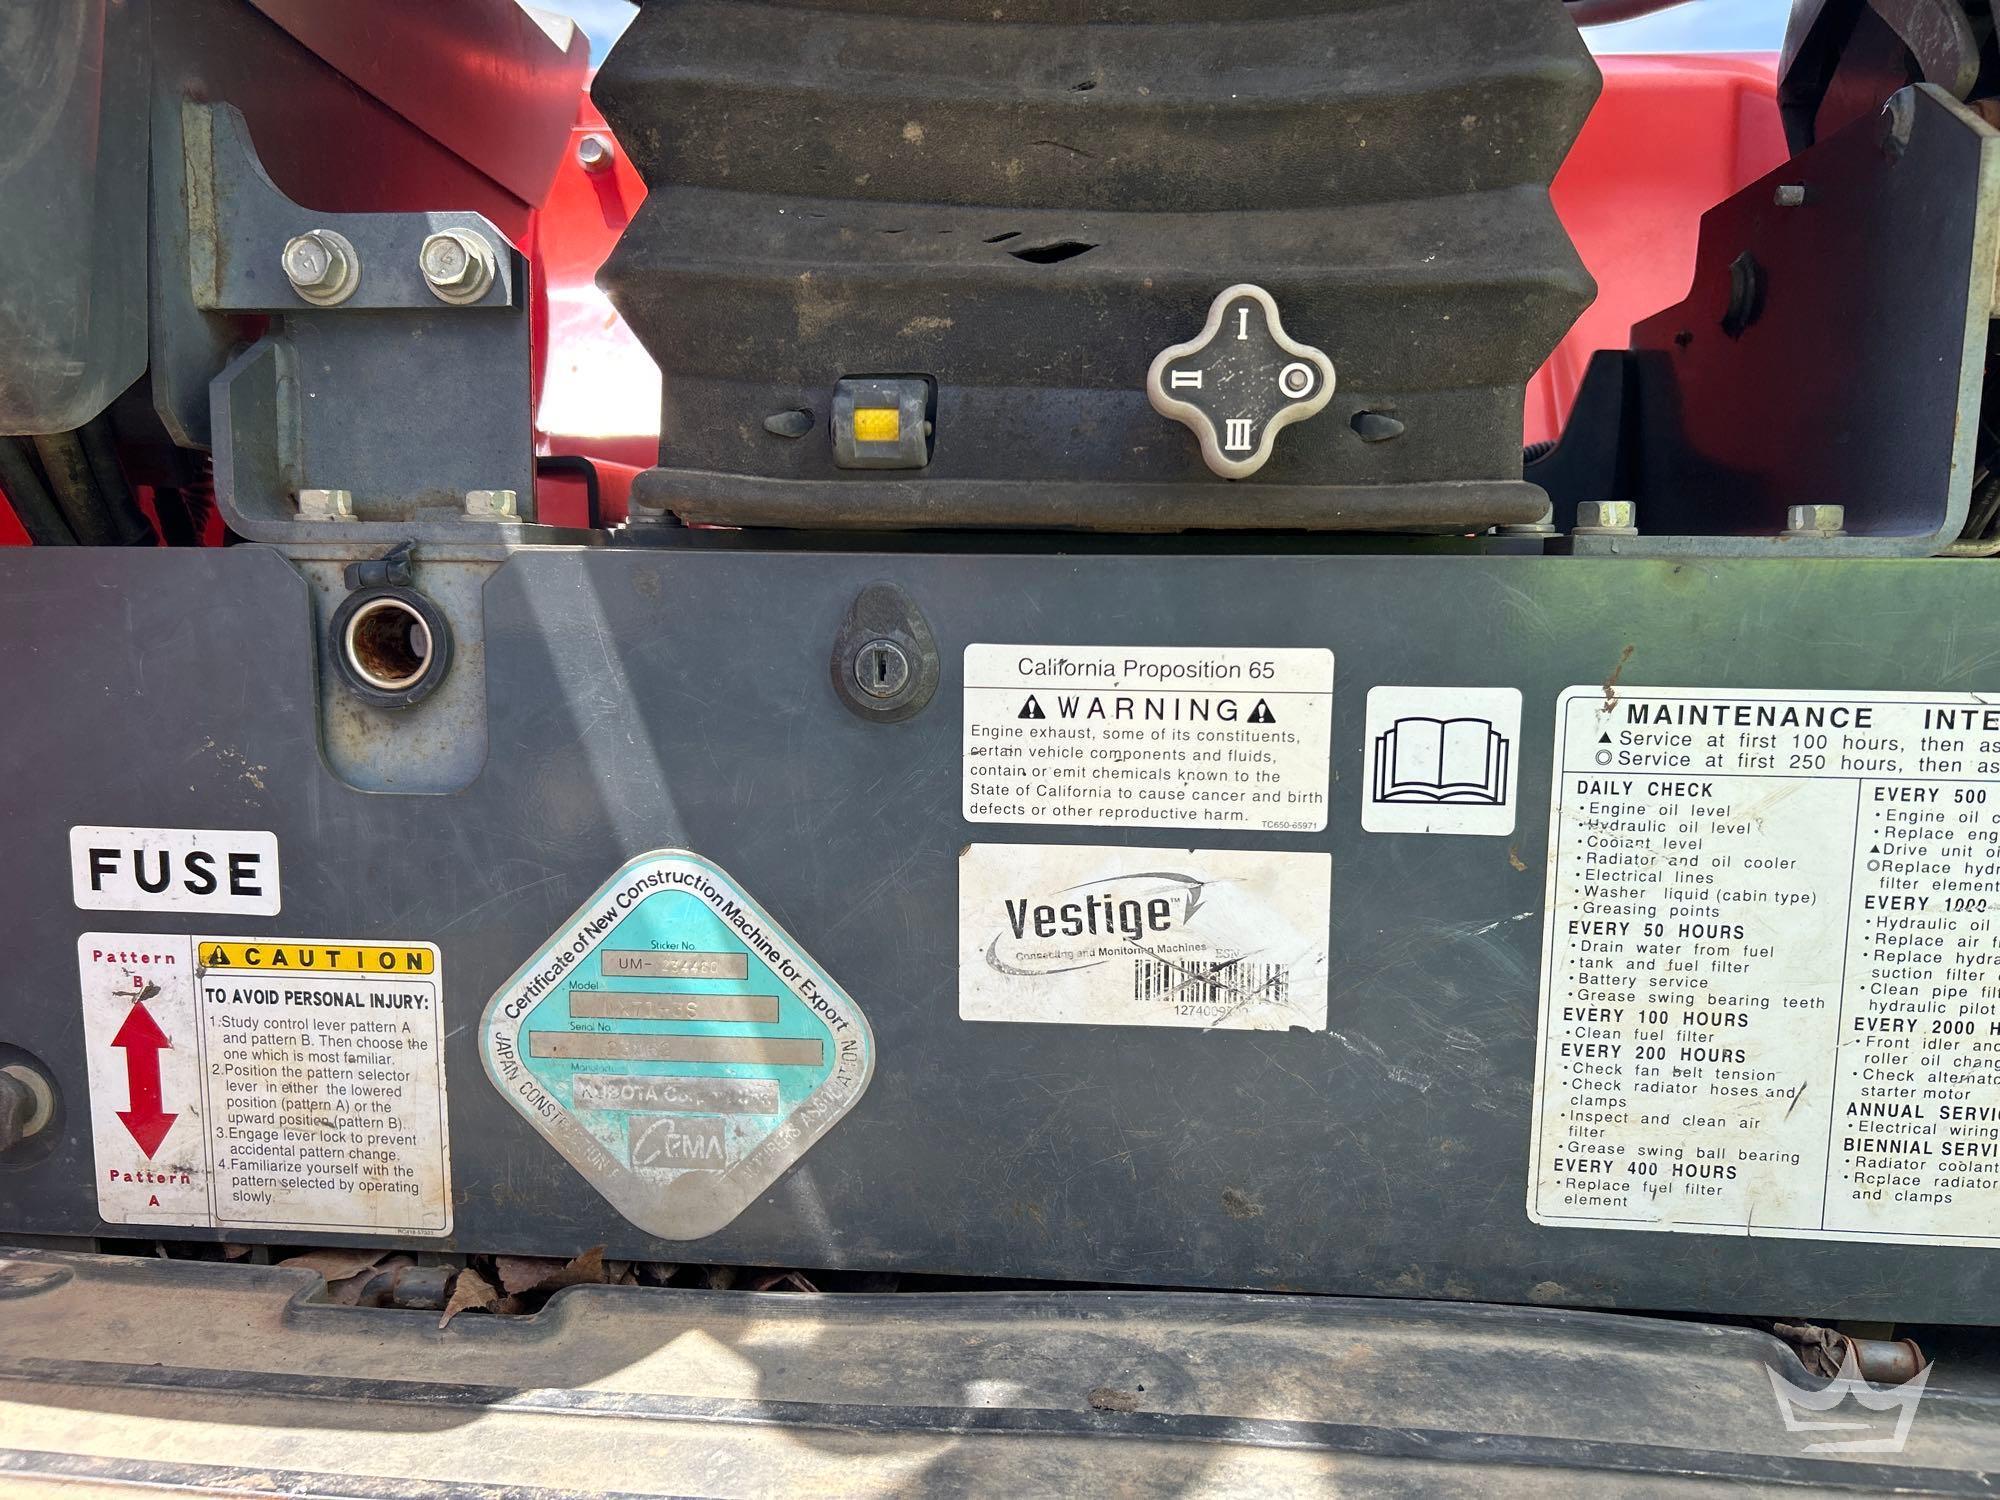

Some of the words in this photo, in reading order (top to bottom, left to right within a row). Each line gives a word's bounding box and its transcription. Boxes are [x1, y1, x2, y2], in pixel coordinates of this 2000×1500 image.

[1018, 657, 1116, 677] California
[1123, 659, 1241, 682] Proposition
[1248, 661, 1275, 679] 65
[1057, 696, 1237, 722] WARNING
[1627, 703, 1872, 728] MAINTENANCE
[971, 724, 1023, 740] Engine
[1029, 725, 1095, 741] exhaust,
[1102, 729, 1144, 740] some
[1150, 727, 1166, 740] of
[1172, 728, 1190, 741] its
[1196, 729, 1300, 744] constituents,
[1619, 730, 1692, 747] Service
[1706, 733, 1725, 747] at
[1738, 732, 1776, 748] first
[1792, 734, 1827, 750] 100
[1842, 734, 1904, 753] hours,
[1920, 735, 1964, 752] then
[970, 744, 1022, 757] certain
[1028, 745, 1083, 759] vehicle
[1090, 749, 1186, 763] components
[1192, 749, 1221, 761] and
[1228, 749, 1276, 764] fluids,
[1617, 750, 1690, 767] Service
[1705, 753, 1723, 767] at
[1737, 752, 1775, 769] first
[1789, 754, 1825, 770] 250
[1840, 754, 1902, 773] hours,
[1918, 756, 1961, 772] then
[970, 764, 1027, 777] contain
[1031, 767, 1047, 777] or
[1053, 765, 1086, 778] emit
[1092, 766, 1171, 781] chemicals
[1177, 768, 1228, 781] known
[1234, 770, 1249, 782] to
[1256, 770, 1280, 783] the
[970, 782, 1009, 796] State
[1015, 783, 1030, 796] of
[1036, 784, 1111, 798] California
[1118, 787, 1132, 799] to
[1138, 789, 1185, 801] cause
[1191, 790, 1246, 801] cancer
[1252, 790, 1281, 803] and
[1287, 790, 1323, 803] birth
[1577, 780, 1633, 795] DAILY
[1647, 781, 1712, 797] CHECK
[1874, 786, 1939, 802] EVERY
[1953, 788, 1986, 804] 500
[969, 802, 1025, 815] defects
[1031, 806, 1046, 816] or
[1052, 804, 1093, 817] other
[1099, 806, 1197, 820] reproductive
[1204, 808, 1248, 821] harm.
[1589, 801, 1646, 818] Engine
[1658, 803, 1678, 816] oil
[1691, 804, 1730, 817] level
[88, 848, 262, 896] FUSE
[1585, 868, 1662, 883] Electrical
[1675, 870, 1714, 884] lines
[1568, 920, 1629, 936] EVERY
[1643, 922, 1663, 937] 50
[1678, 923, 1744, 940] HOURS
[504, 950, 576, 1019] Certificate
[573, 932, 589, 954] of
[583, 907, 618, 940] New
[616, 870, 723, 909] Construction
[721, 900, 781, 963] Machine
[778, 958, 803, 982] for
[799, 978, 849, 1032] Export
[651, 940, 679, 950] Sticker
[1157, 943, 1207, 954] Machines
[92, 949, 175, 964] Pattern
[244, 948, 422, 970] CAUTION
[133, 975, 144, 988] B
[569, 980, 599, 989] Model
[204, 987, 226, 1003] TO
[232, 988, 279, 1005] AVOID
[284, 990, 365, 1008] PERSONAL
[369, 992, 428, 1010] INJURY:
[1577, 988, 1635, 1002] Grease
[1648, 991, 1694, 1007] swing
[1707, 992, 1769, 1010] bearing
[1783, 996, 1825, 1009] teeth
[263, 1017, 308, 1030] control
[313, 1018, 346, 1031] lever
[350, 1020, 397, 1034] pattern
[401, 1021, 411, 1034] A
[1563, 1007, 1624, 1023] EVERY
[1638, 1009, 1668, 1025] 100
[1682, 1011, 1748, 1028] HOURS
[1854, 1016, 1917, 1033] EVERY
[1931, 1019, 1975, 1035] 2000
[222, 1032, 247, 1044] and
[251, 1033, 297, 1047] pattern
[301, 1033, 314, 1046] B.
[318, 1034, 352, 1048] Then
[356, 1036, 403, 1050] choose
[407, 1037, 428, 1051] the
[223, 1049, 248, 1060] one
[251, 1048, 289, 1062] which
[293, 1049, 304, 1062] is
[308, 1051, 340, 1063] most
[343, 1050, 395, 1065] familiar.
[495, 1031, 521, 1081] JAPAN
[281, 1065, 302, 1078] the
[307, 1067, 353, 1081] pattern
[357, 1068, 410, 1082] selector
[1861, 1085, 1916, 1098] starter
[1923, 1088, 1971, 1100] motor
[283, 1126, 317, 1142] lever
[319, 1129, 346, 1143] lock
[350, 1131, 363, 1144] to
[367, 1134, 417, 1147] prevent
[229, 1143, 295, 1157] accidental
[299, 1146, 344, 1160] pattern
[347, 1147, 400, 1164] change.
[109, 1169, 191, 1184] Pattern
[306, 1162, 358, 1176] yourself
[362, 1163, 389, 1176] with
[393, 1164, 414, 1178] the
[231, 1175, 277, 1188] pattern
[278, 1176, 335, 1190] selected
[339, 1178, 354, 1193] by
[358, 1180, 419, 1197] operating
[148, 1195, 160, 1207] A
[1564, 1193, 1628, 1207] element
[1852, 1188, 1882, 1200] and
[1894, 1189, 1952, 1205] clamps
